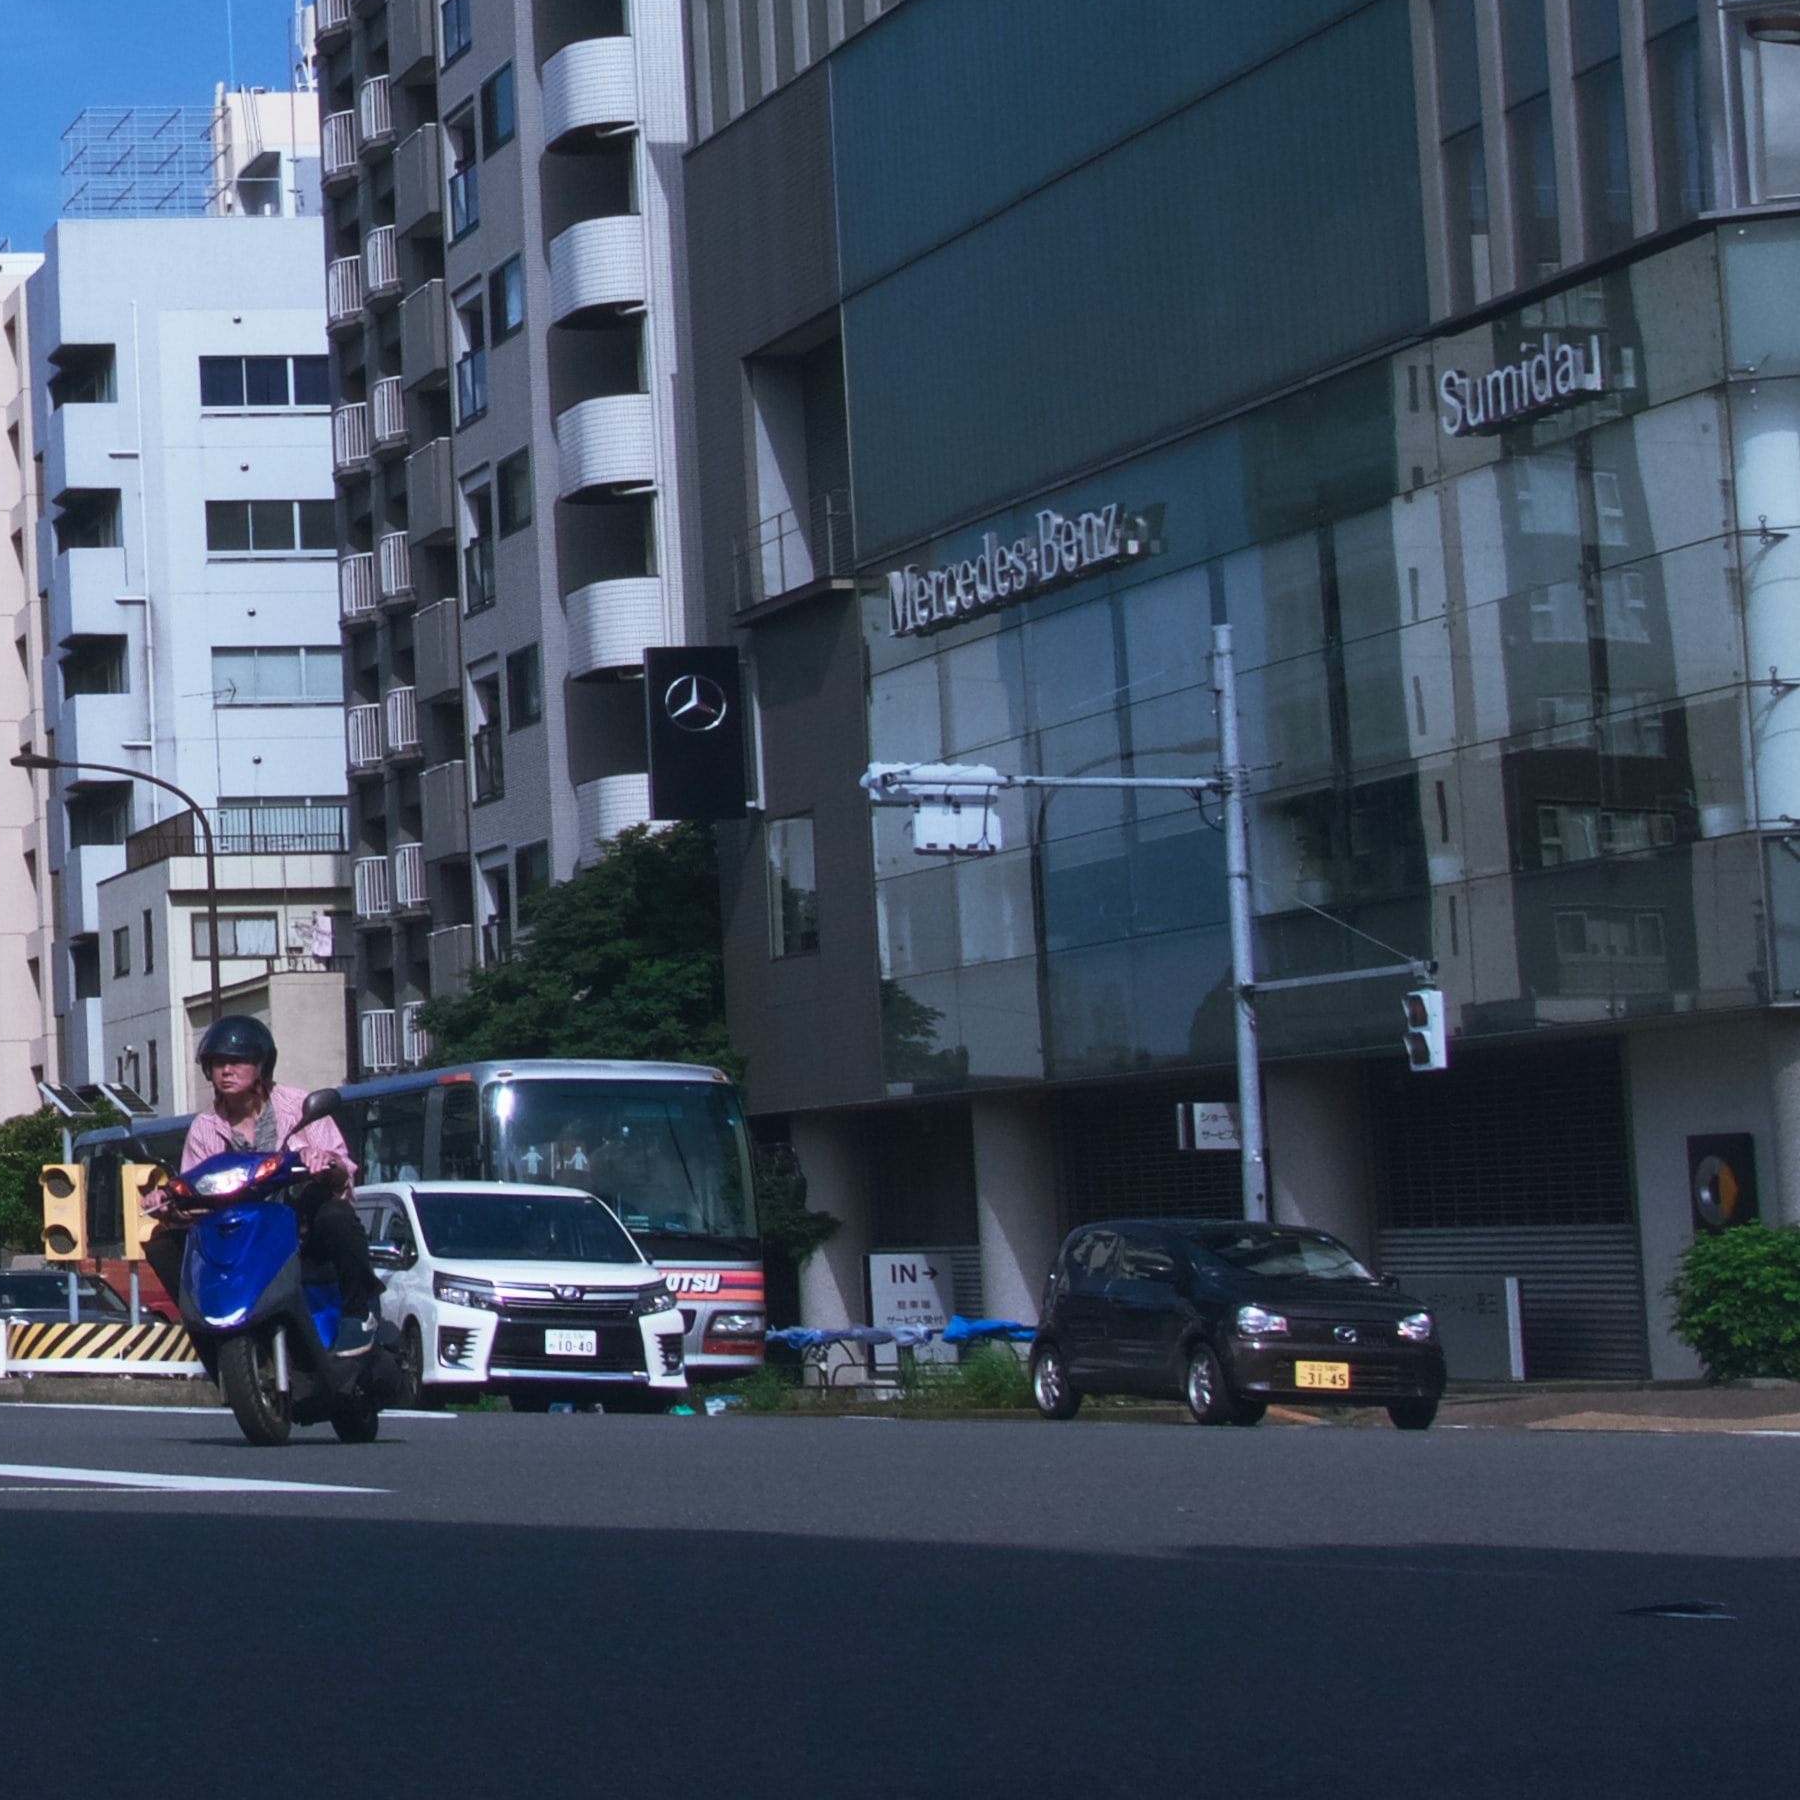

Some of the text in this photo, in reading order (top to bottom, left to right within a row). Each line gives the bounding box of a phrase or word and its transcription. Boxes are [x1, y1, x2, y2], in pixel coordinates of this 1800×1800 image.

[1440, 333, 1574, 435] Sumida
[887, 503, 1119, 638] Mercedes-Benz
[891, 1264, 918, 1283] IN
[887, 1314, 944, 1325] サービス受付
[559, 1340, 593, 1353] 10-40
[1308, 1372, 1346, 1387] 31-45
